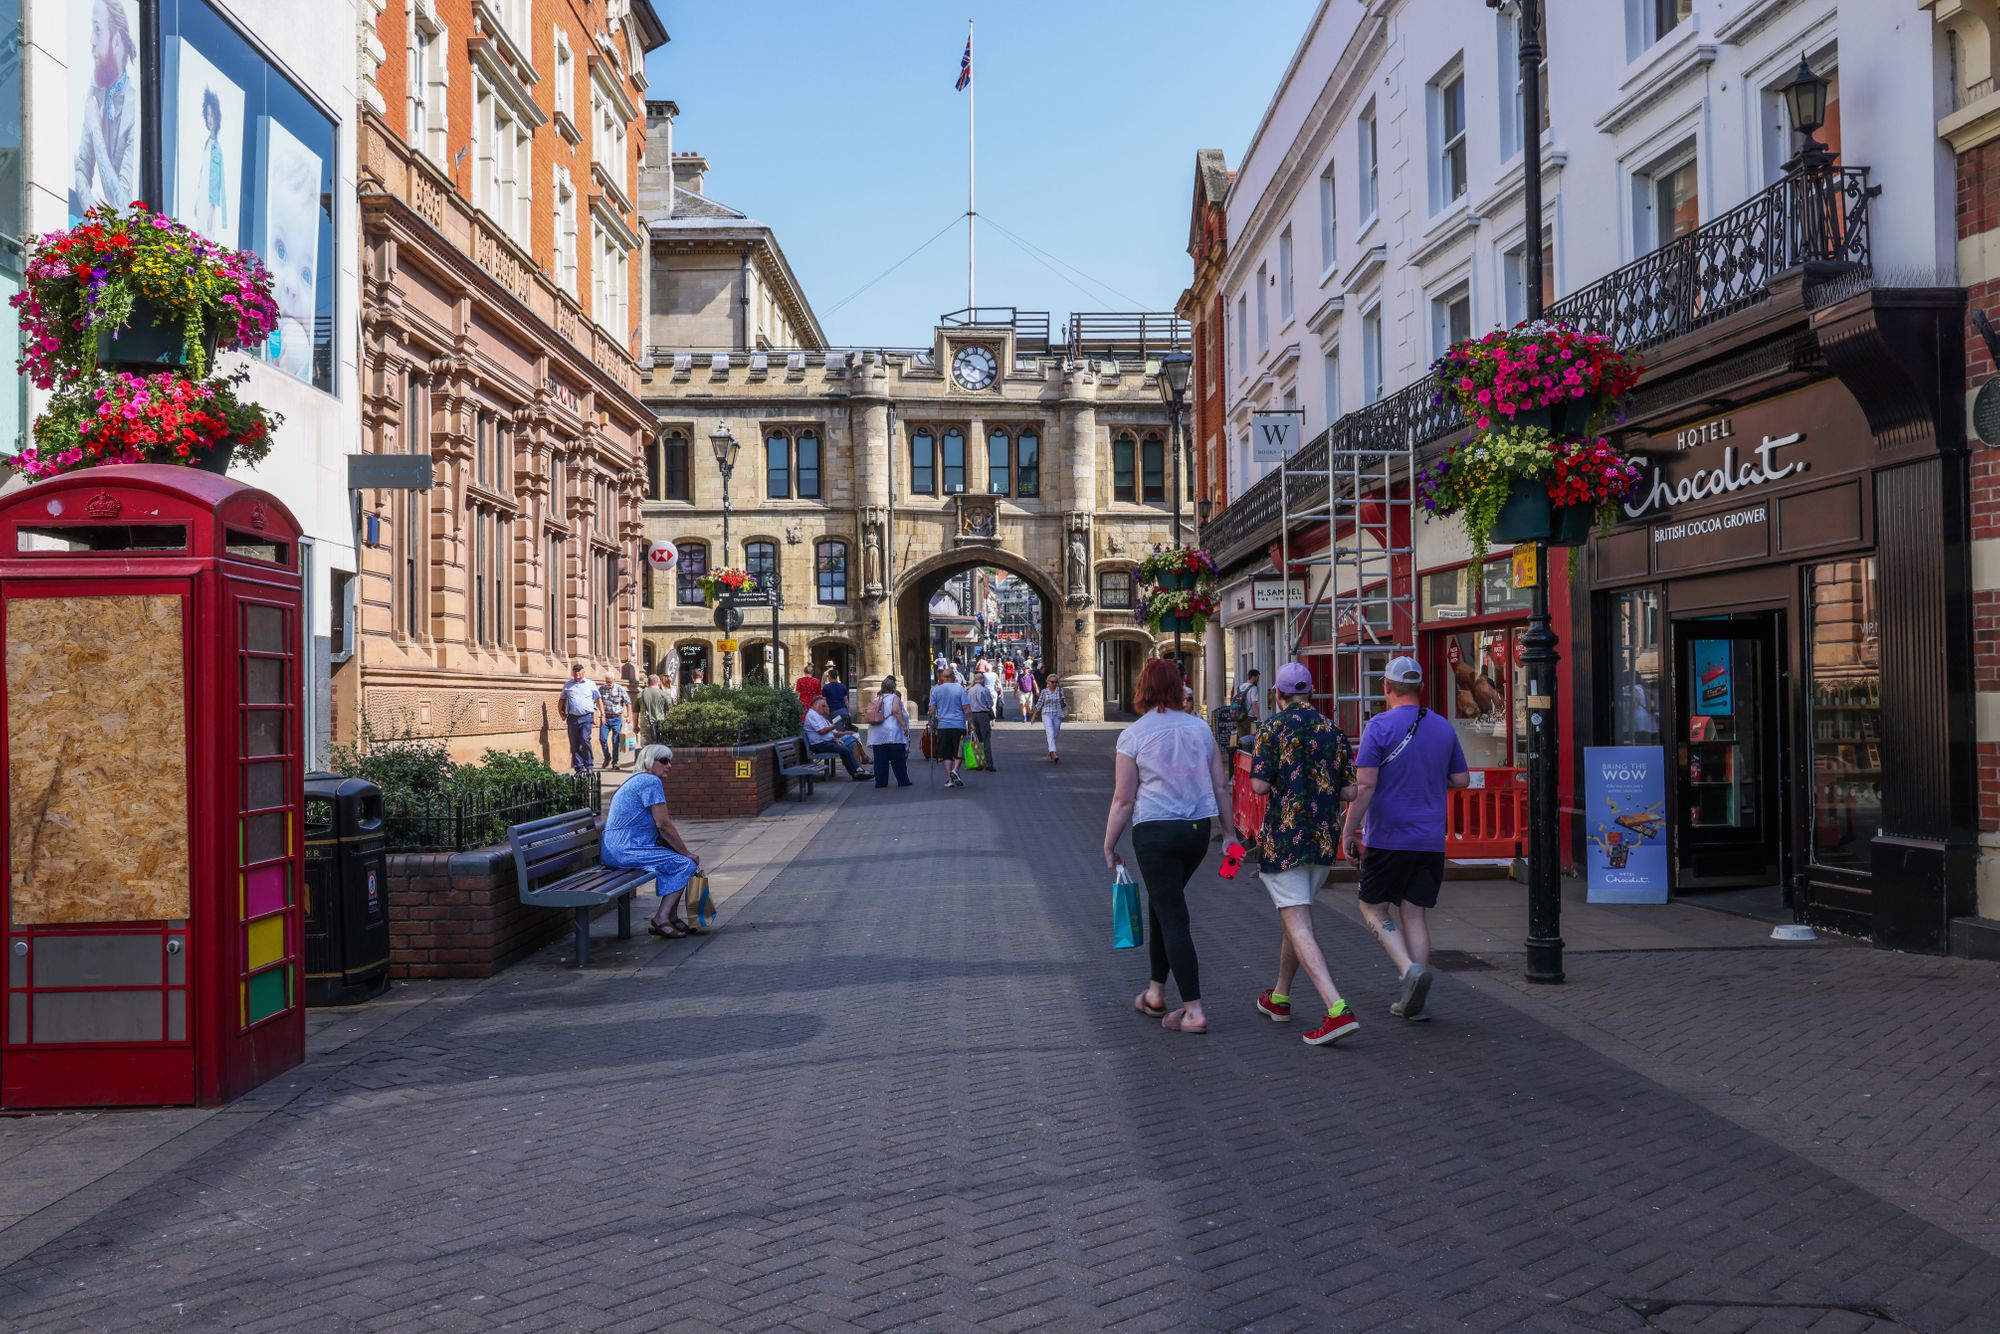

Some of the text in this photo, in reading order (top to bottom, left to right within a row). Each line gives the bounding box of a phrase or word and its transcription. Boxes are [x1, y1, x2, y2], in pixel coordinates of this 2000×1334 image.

[1260, 424, 1291, 446] W
[1677, 419, 1730, 450] HOTEL
[1654, 508, 1766, 543] BRITISH COCOA GROWER
[738, 762, 749, 776] H
[1602, 770, 1647, 781] WOW
